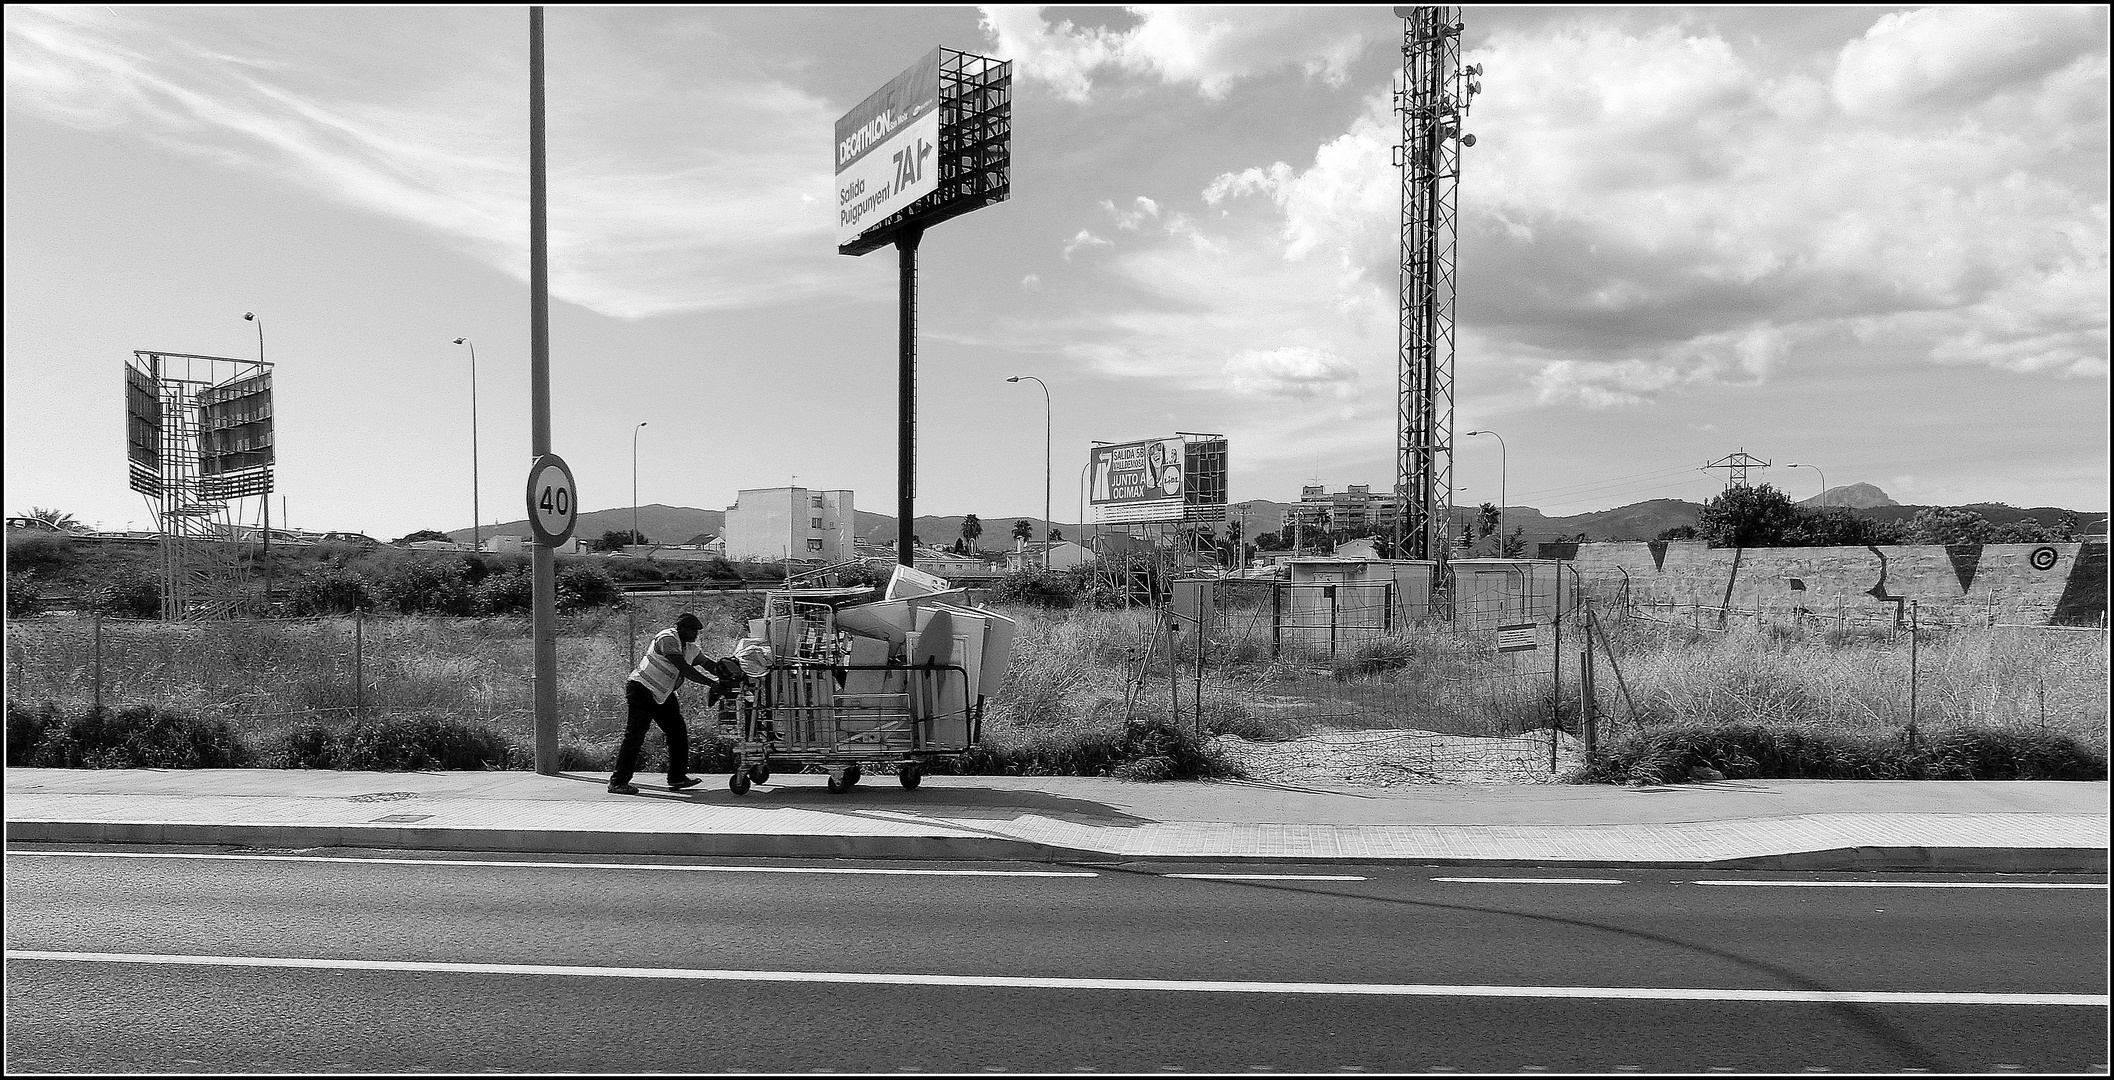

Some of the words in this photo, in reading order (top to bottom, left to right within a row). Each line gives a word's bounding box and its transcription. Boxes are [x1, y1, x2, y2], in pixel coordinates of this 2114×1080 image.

[839, 108, 890, 165] DECATHLON
[840, 178, 865, 206] Salida
[840, 181, 891, 228] Puigpunyent
[1113, 449, 1135, 460] SALIDA
[1111, 473, 1138, 487] JUNTO
[1140, 472, 1146, 484] A
[1113, 485, 1145, 499] OCIMAX
[539, 485, 569, 516] 40
